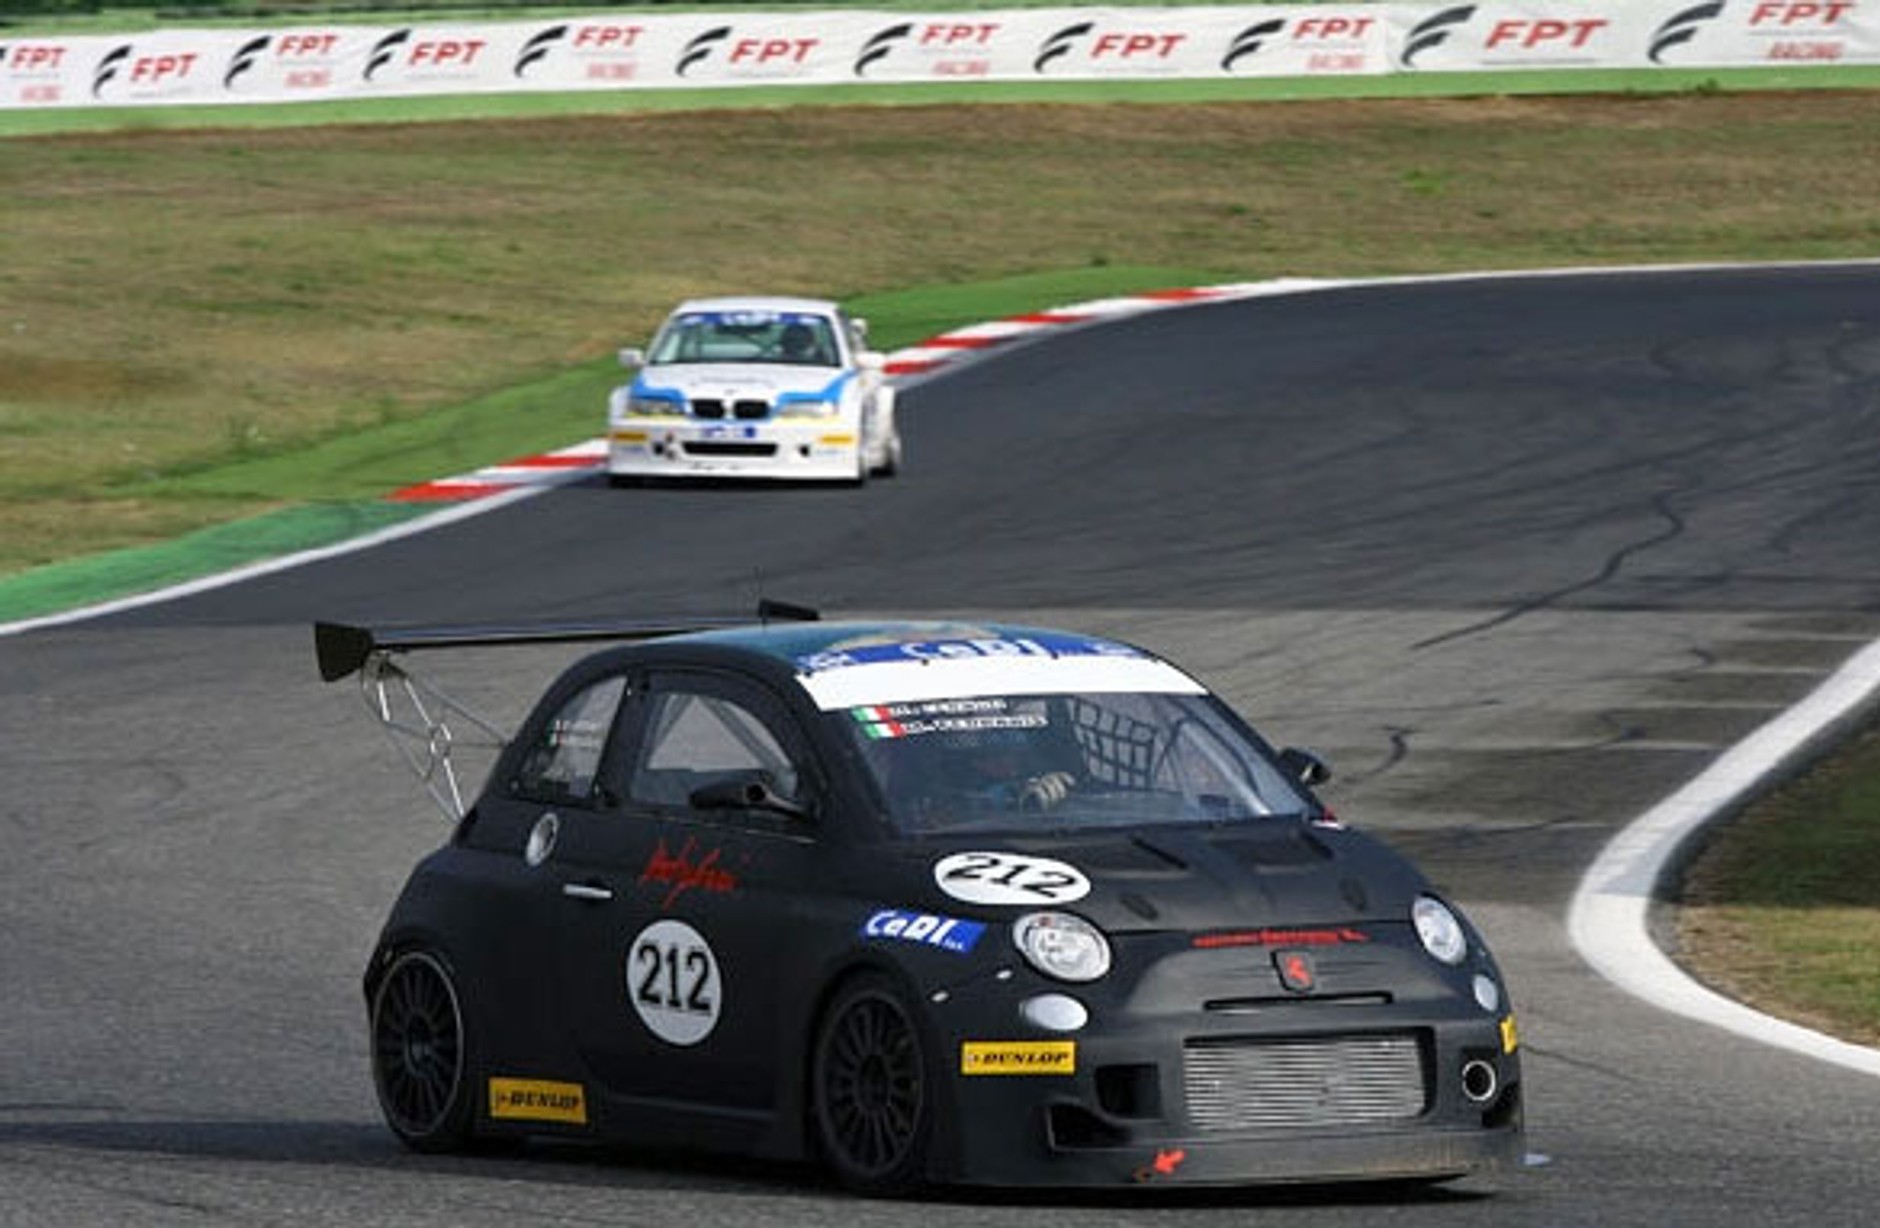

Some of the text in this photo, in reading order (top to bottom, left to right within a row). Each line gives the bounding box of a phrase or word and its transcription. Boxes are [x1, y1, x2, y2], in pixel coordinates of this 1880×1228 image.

[1748, 0, 1853, 26] FPT
[574, 25, 643, 47] FPT
[921, 23, 1000, 45] FPT
[1292, 18, 1375, 39] FPT
[1485, 18, 1607, 49] FPT
[11, 47, 66, 69] FPT
[276, 35, 340, 56] FPT
[409, 40, 486, 66] FPT
[728, 38, 818, 63] FPT
[1092, 33, 1185, 58] FPT
[130, 53, 197, 81] FPT
[945, 855, 1077, 898] 212
[636, 944, 711, 1012] 212
[982, 1052, 1070, 1066] DUNLOP
[510, 1090, 580, 1108] DUNLOP
